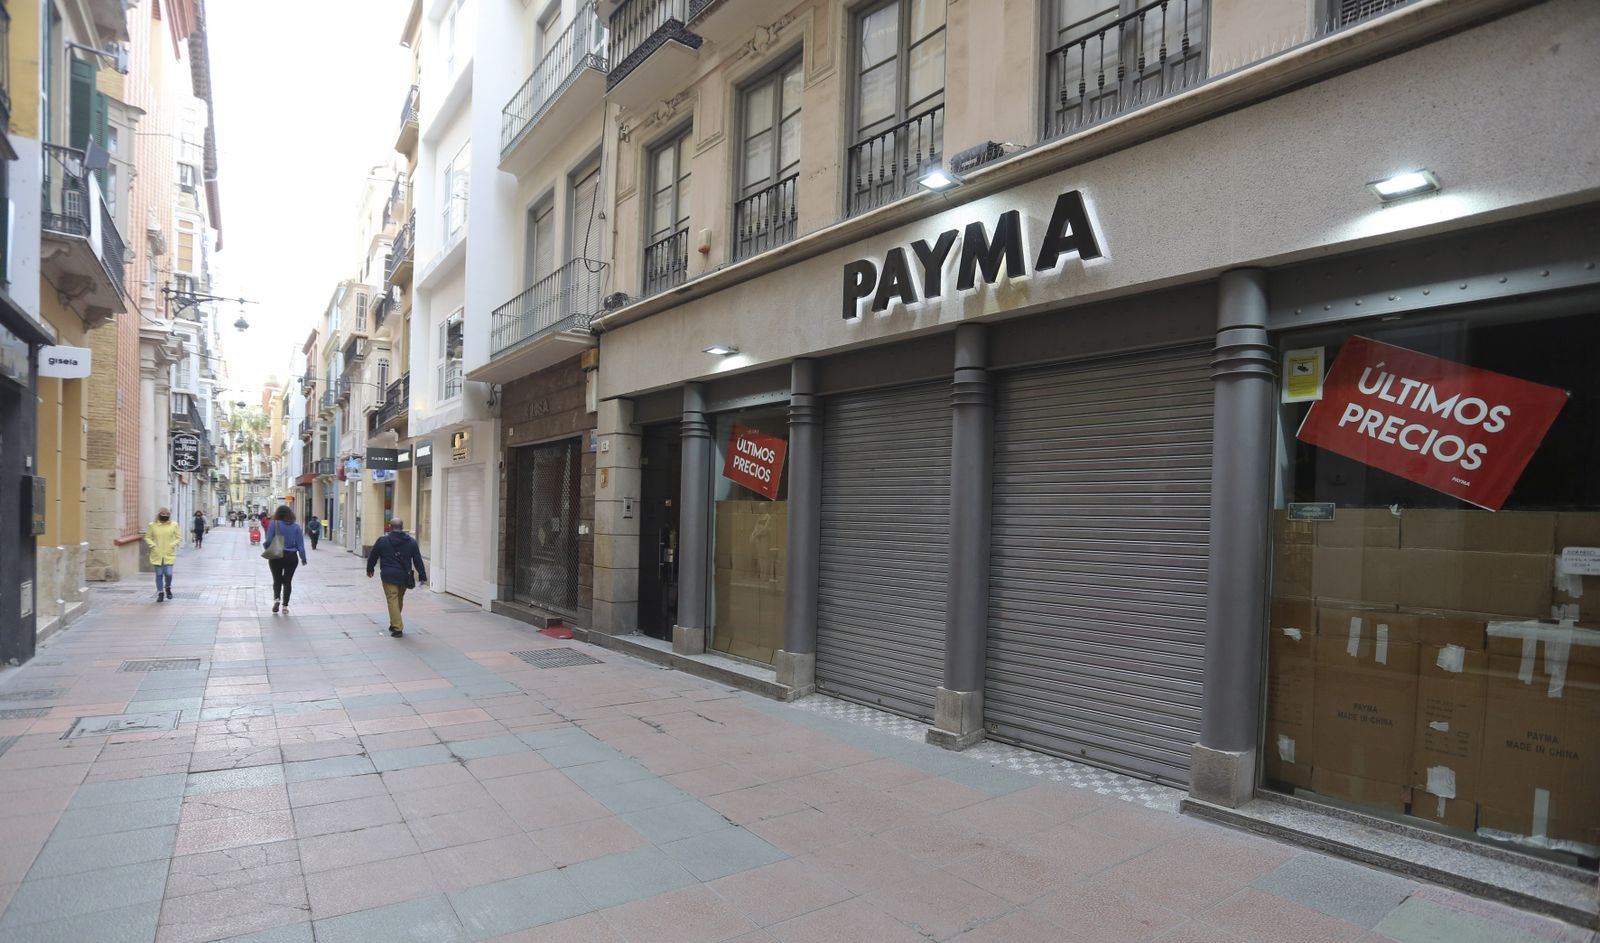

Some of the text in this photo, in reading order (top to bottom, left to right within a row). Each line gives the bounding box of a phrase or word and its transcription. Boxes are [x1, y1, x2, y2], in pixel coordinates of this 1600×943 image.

[842, 189, 1103, 320] PAYMA
[48, 357, 78, 366] gisela
[1357, 361, 1512, 433] ÚLTIMOS
[736, 434, 776, 464] ÚLTIMOS
[1337, 402, 1488, 471] PRECIOS
[732, 455, 771, 482] PRECIOS
[1505, 740, 1580, 760] MADE IN CHINA
[1527, 731, 1560, 745] PAYMA
